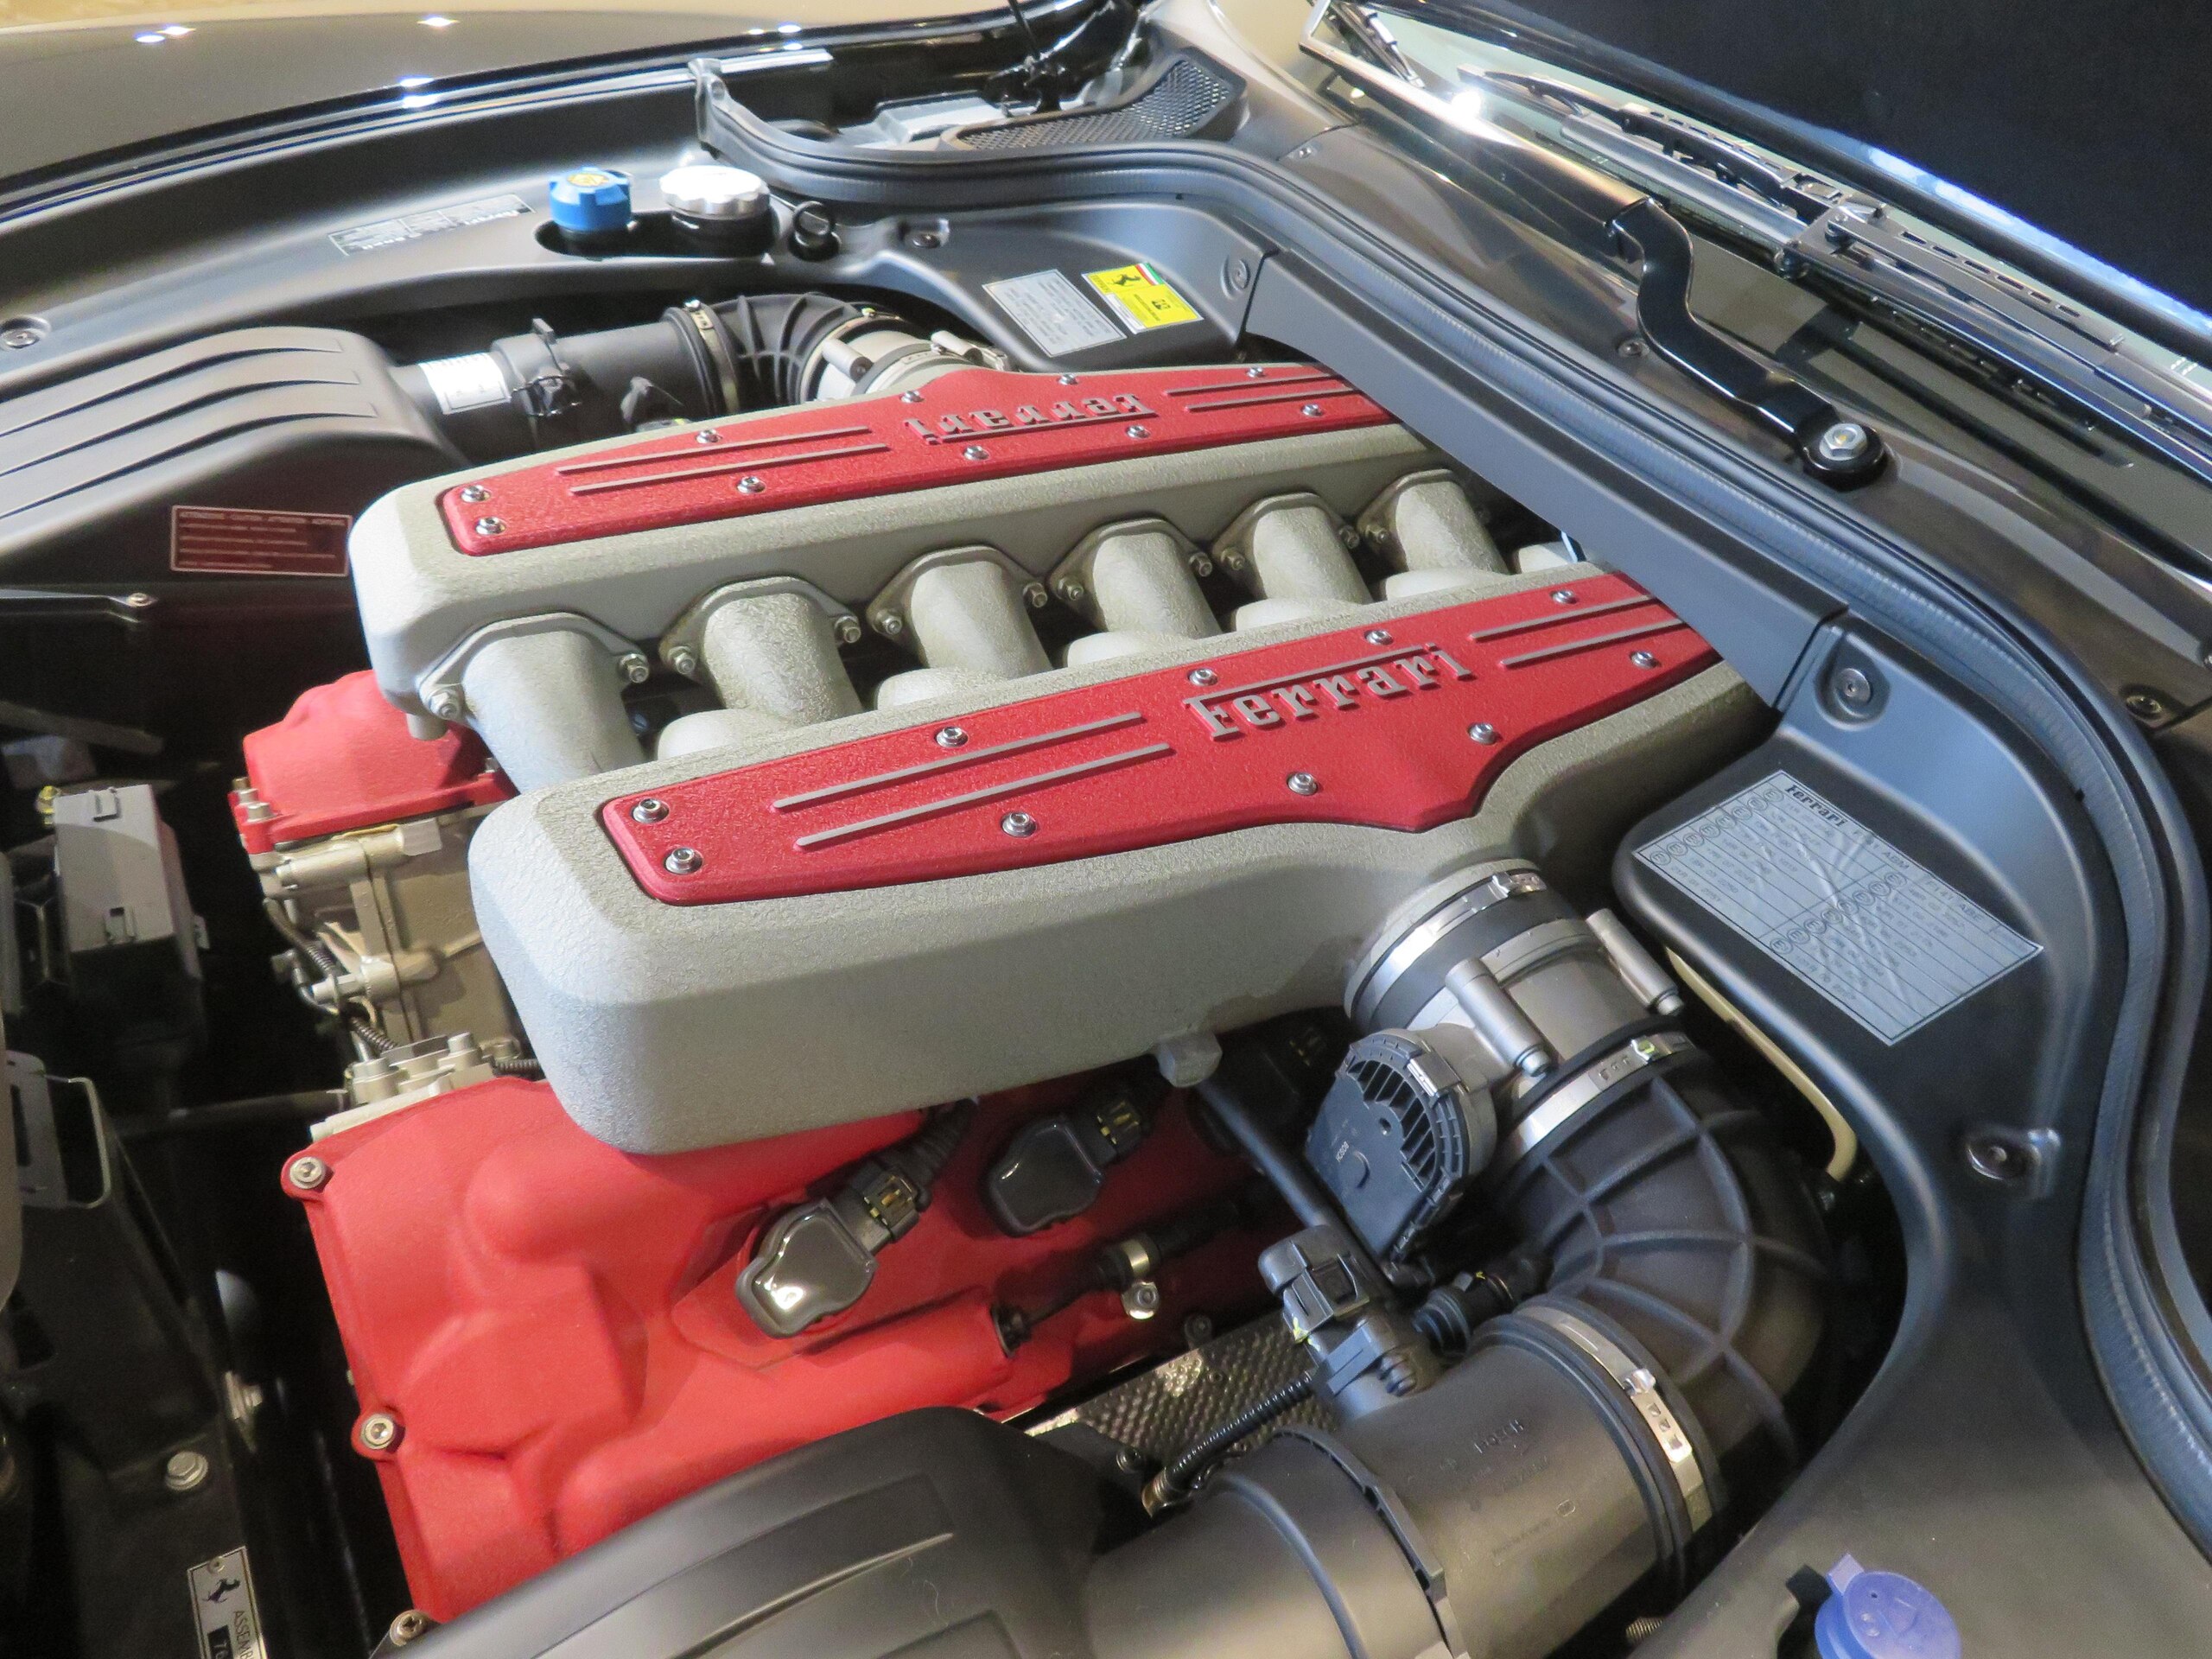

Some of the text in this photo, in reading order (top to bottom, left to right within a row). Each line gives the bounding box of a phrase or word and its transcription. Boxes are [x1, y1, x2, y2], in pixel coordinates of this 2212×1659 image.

[906, 394, 1159, 444] Ferrari
[1183, 642, 1472, 740] Ferrari
[1783, 784, 1848, 827] Ferrari
